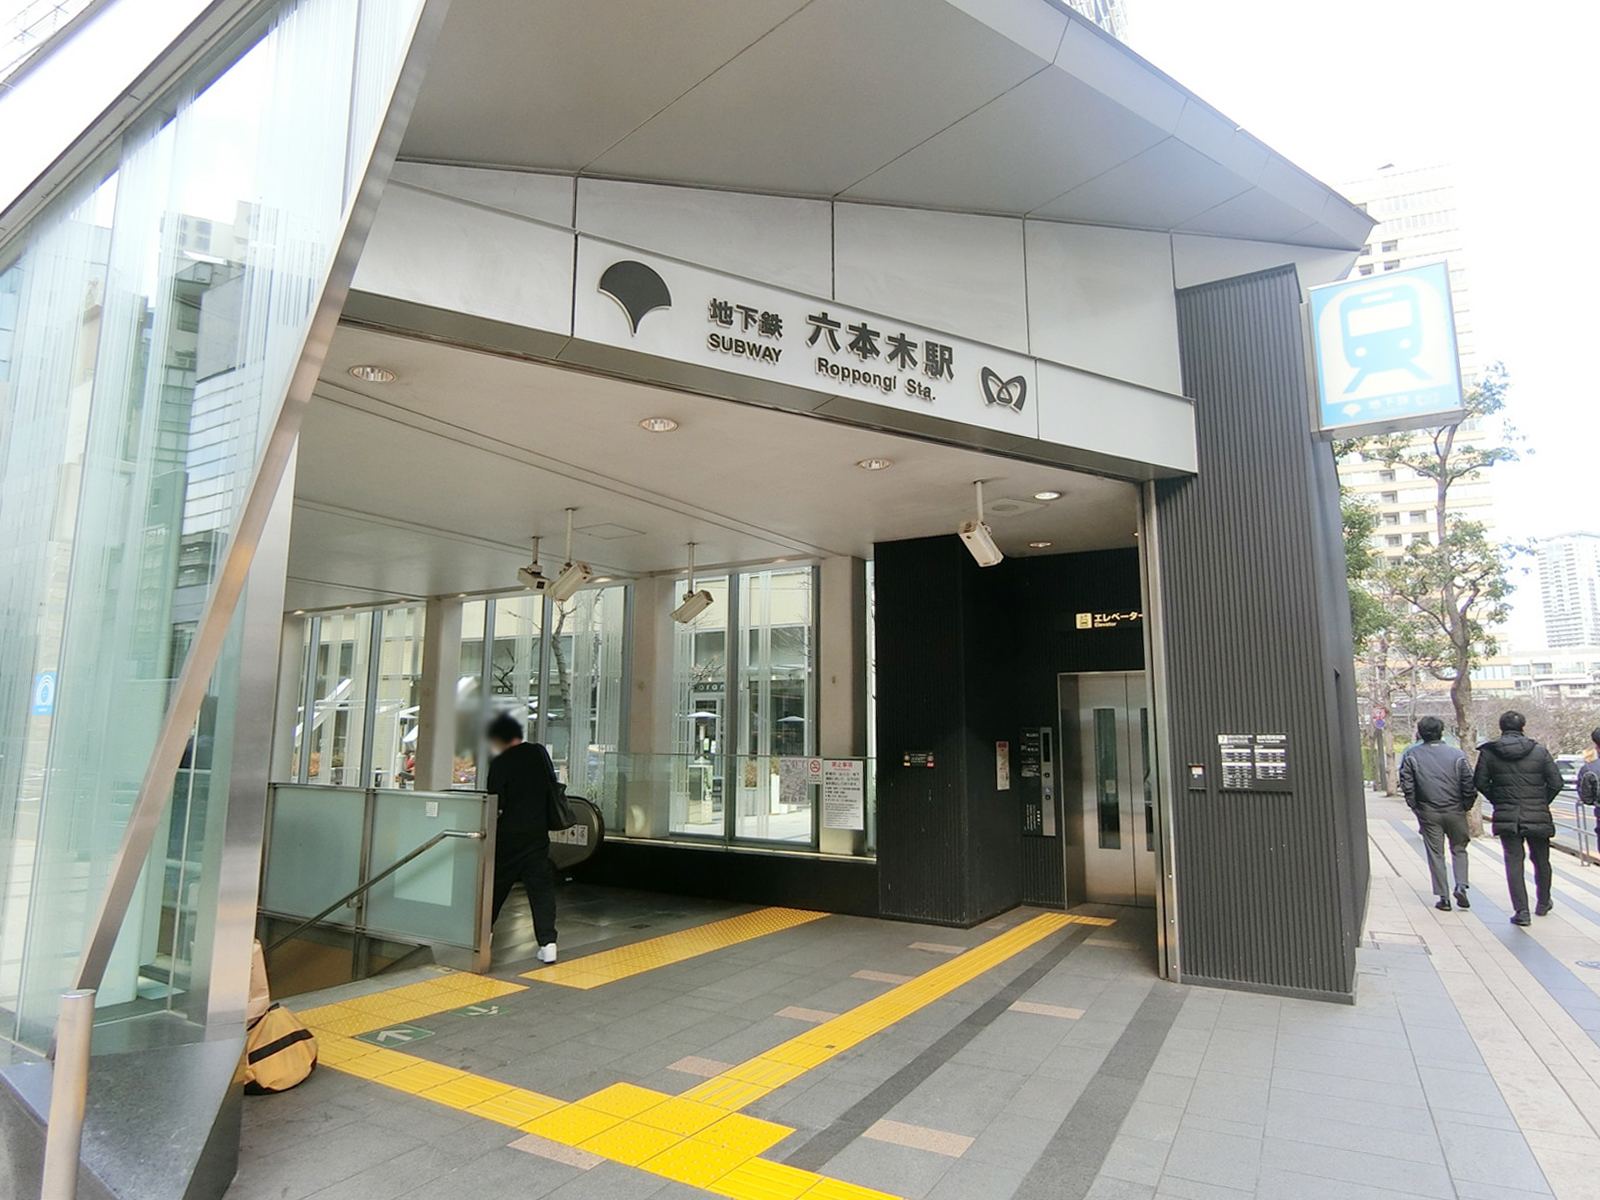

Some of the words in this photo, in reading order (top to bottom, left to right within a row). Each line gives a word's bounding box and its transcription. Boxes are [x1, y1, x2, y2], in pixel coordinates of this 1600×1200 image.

[708, 297, 783, 340] 地下鉄
[707, 333, 783, 364] SUBWAY
[805, 311, 954, 382] 六本木駅
[815, 357, 897, 393] Roppongi
[904, 378, 936, 403] Sta.
